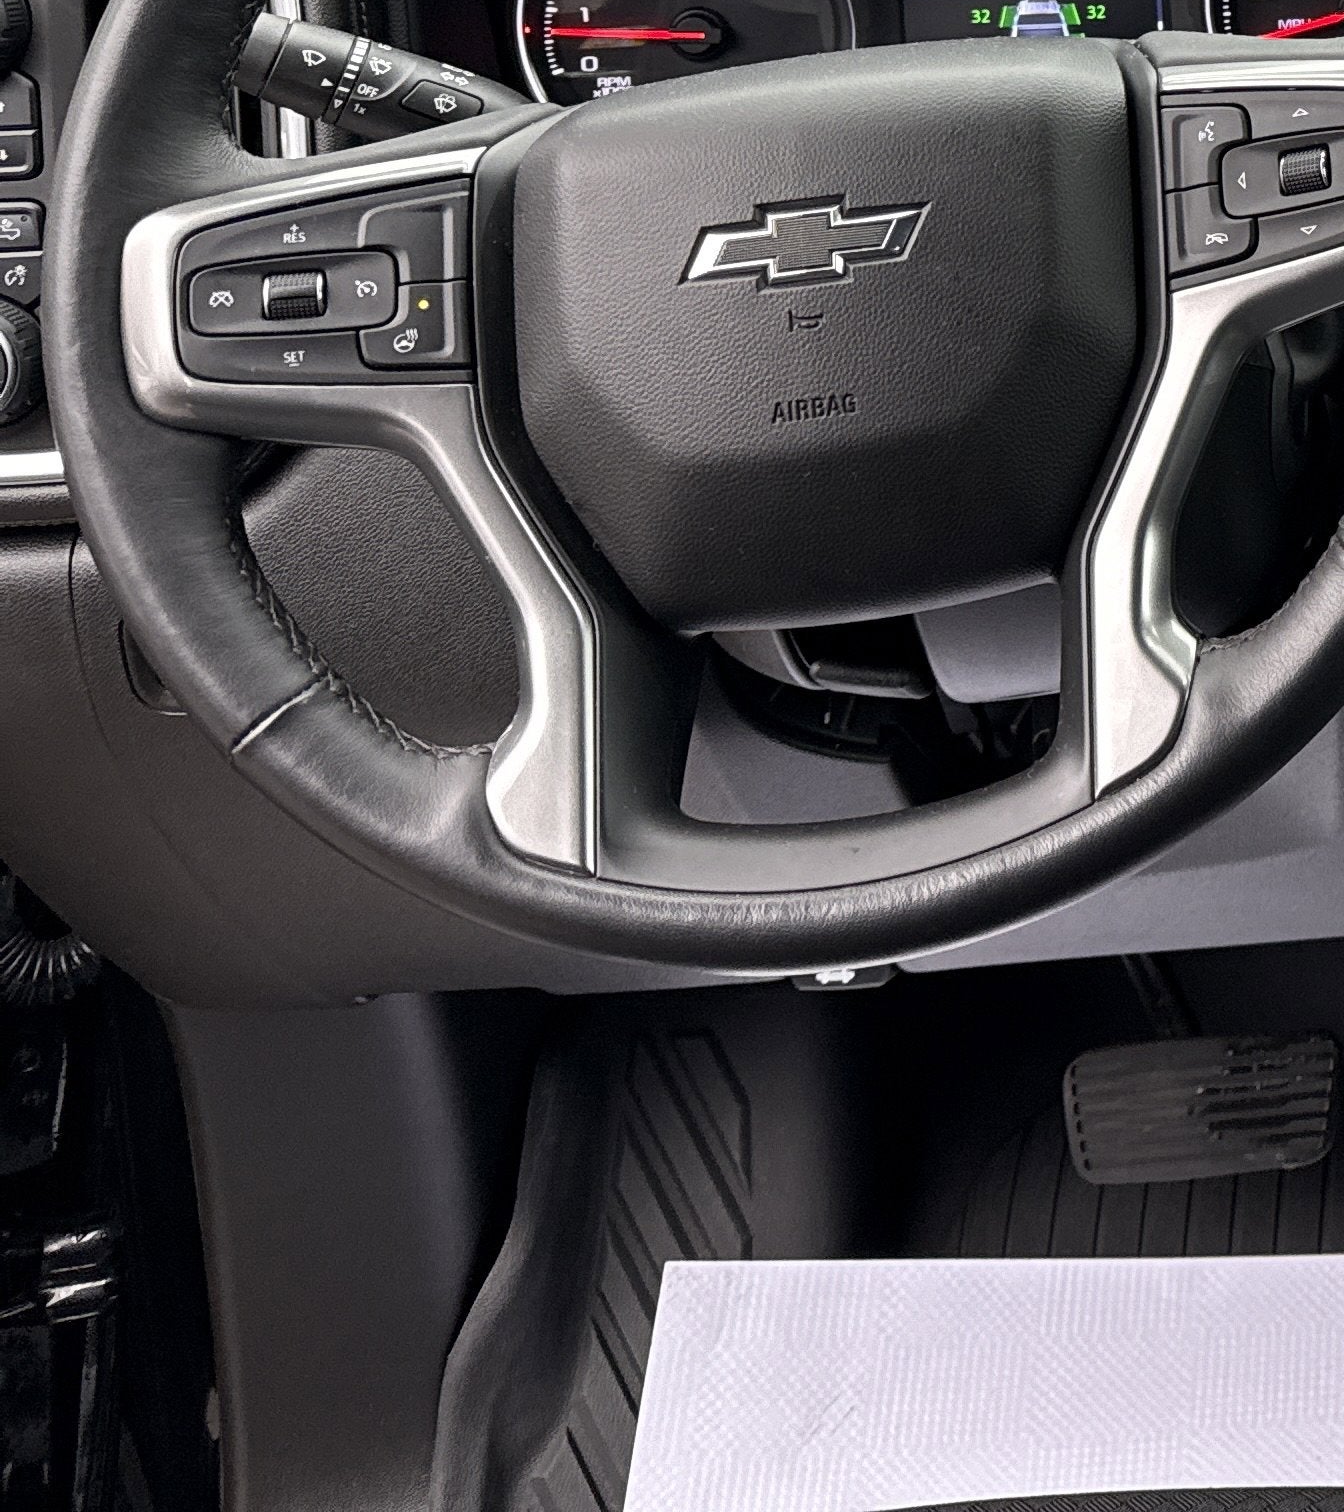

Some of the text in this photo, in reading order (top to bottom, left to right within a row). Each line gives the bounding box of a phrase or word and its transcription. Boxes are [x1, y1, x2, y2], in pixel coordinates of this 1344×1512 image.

[579, 7, 590, 23] 1
[970, 9, 991, 24] 32
[1085, 5, 1106, 20] 32
[1277, 18, 1312, 31] MP
[580, 56, 599, 71] 0
[596, 76, 632, 89] RPM
[356, 83, 379, 98] OFF
[353, 103, 367, 115] 1x
[283, 232, 307, 244] RES
[283, 350, 306, 364] SET
[771, 392, 858, 425] AIRBAG
